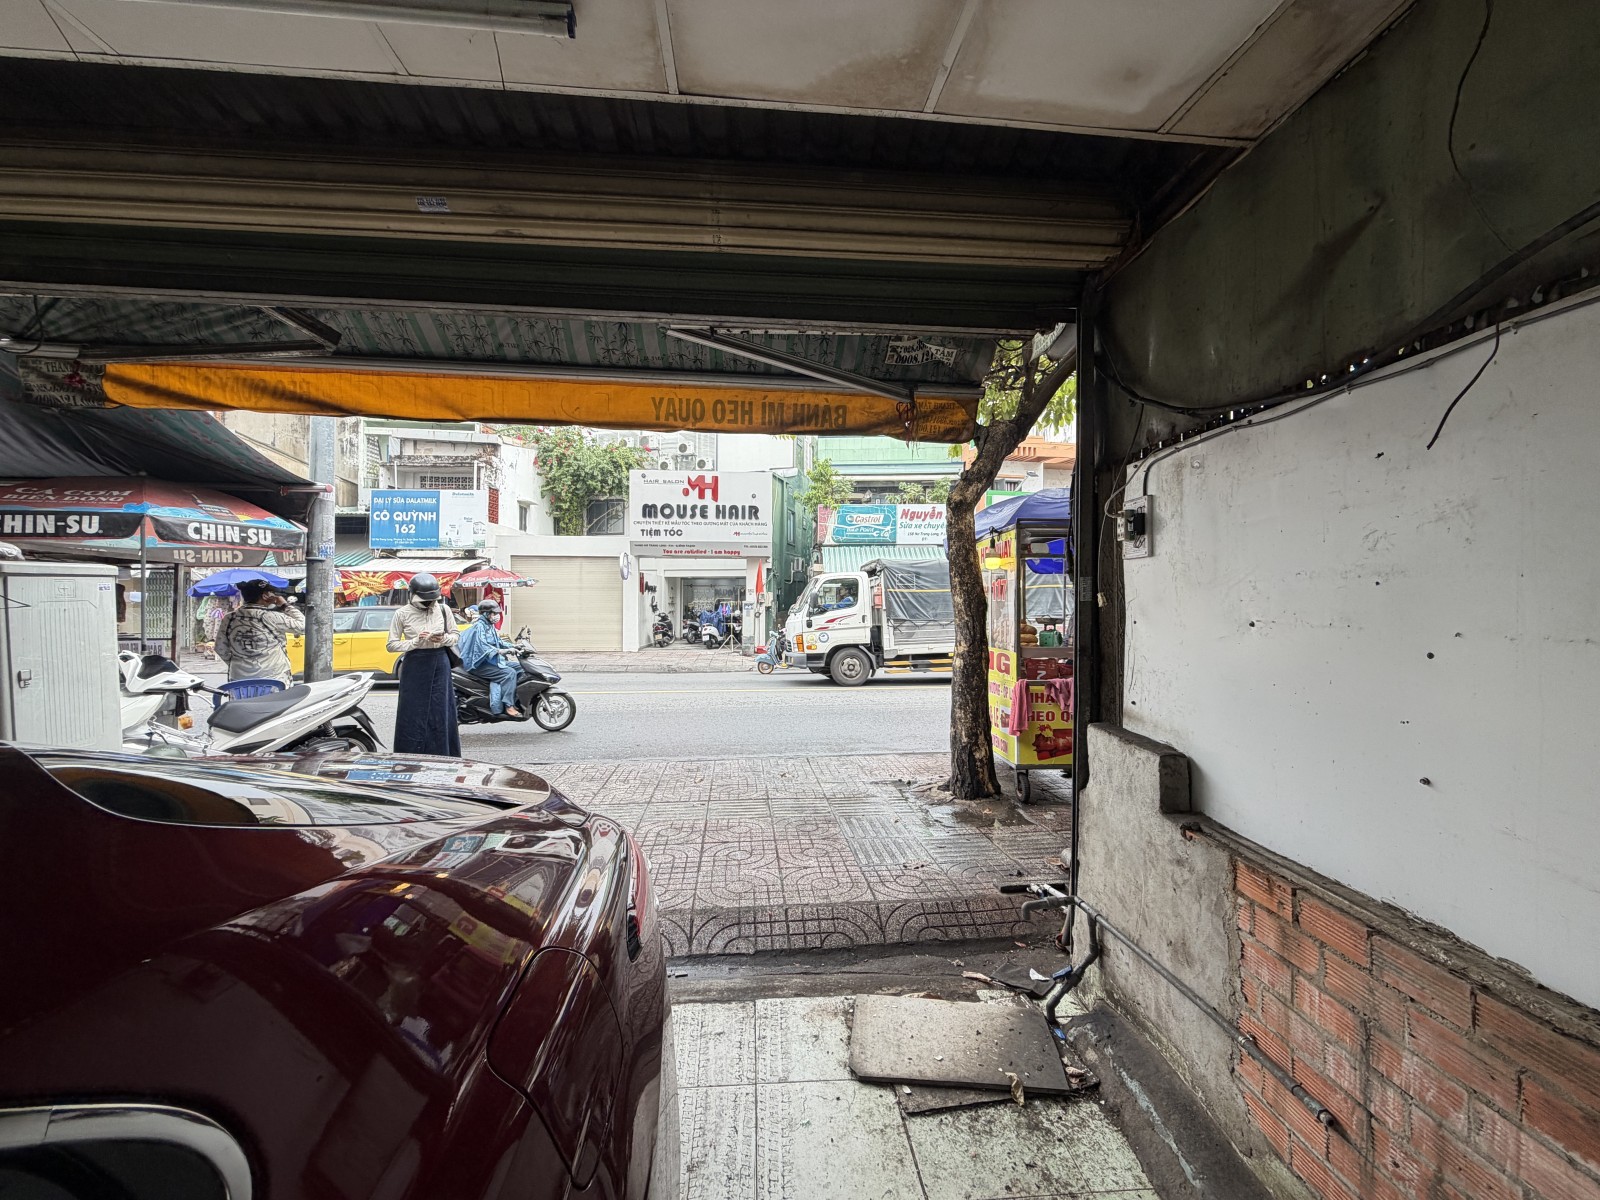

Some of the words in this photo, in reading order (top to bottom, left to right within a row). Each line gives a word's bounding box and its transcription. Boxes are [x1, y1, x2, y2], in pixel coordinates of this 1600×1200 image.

[373, 509, 390, 521] CÔ
[393, 510, 437, 522] QUỲNH
[642, 503, 708, 520] MOUSE
[715, 505, 760, 520] HAIR
[900, 506, 943, 521] Nguyễn
[0, 514, 100, 534] HIN-SU
[854, 515, 881, 523] Castrol
[395, 524, 416, 534] 162
[640, 527, 661, 538] TIỆM
[663, 527, 683, 537] TÓC
